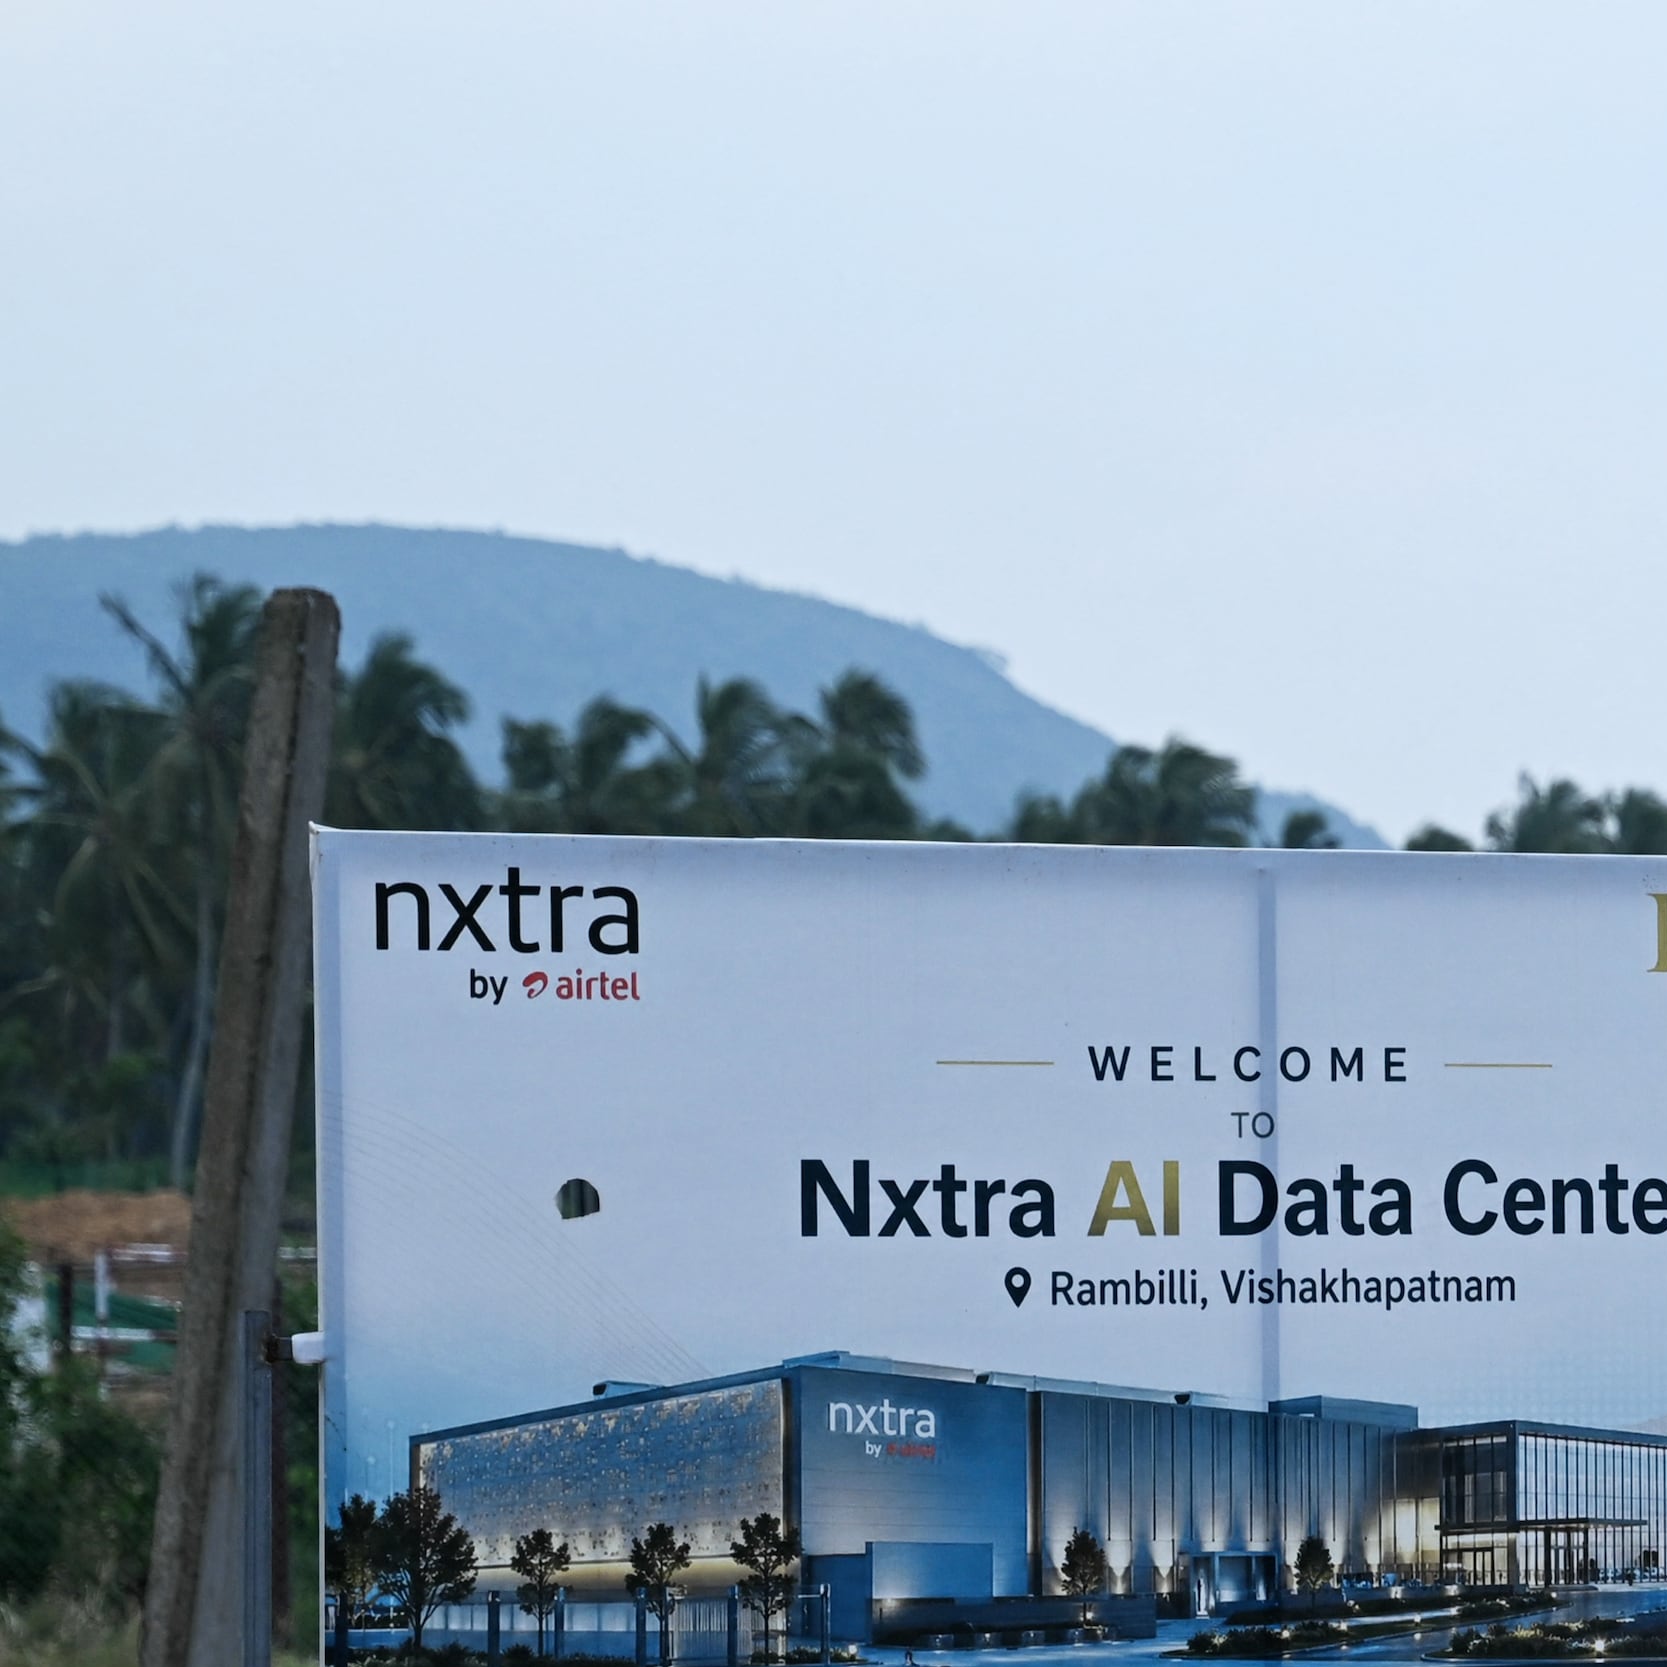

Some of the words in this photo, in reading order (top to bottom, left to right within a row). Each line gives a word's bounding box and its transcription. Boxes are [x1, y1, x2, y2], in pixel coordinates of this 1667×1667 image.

[376, 867, 638, 954] nxtra
[470, 969, 508, 1005] by
[556, 968, 640, 1000] airtel
[1088, 1046, 1406, 1082] WELCOME
[1231, 1112, 1274, 1138] TO
[801, 1160, 1055, 1238] Nxtra
[1088, 1161, 1179, 1236] AI
[1219, 1160, 1412, 1236] Data
[1052, 1269, 1207, 1310] Rambilli,
[1221, 1268, 1515, 1310] Vishakhapatnam
[830, 1399, 935, 1438] nxtra
[866, 1441, 881, 1457] by
